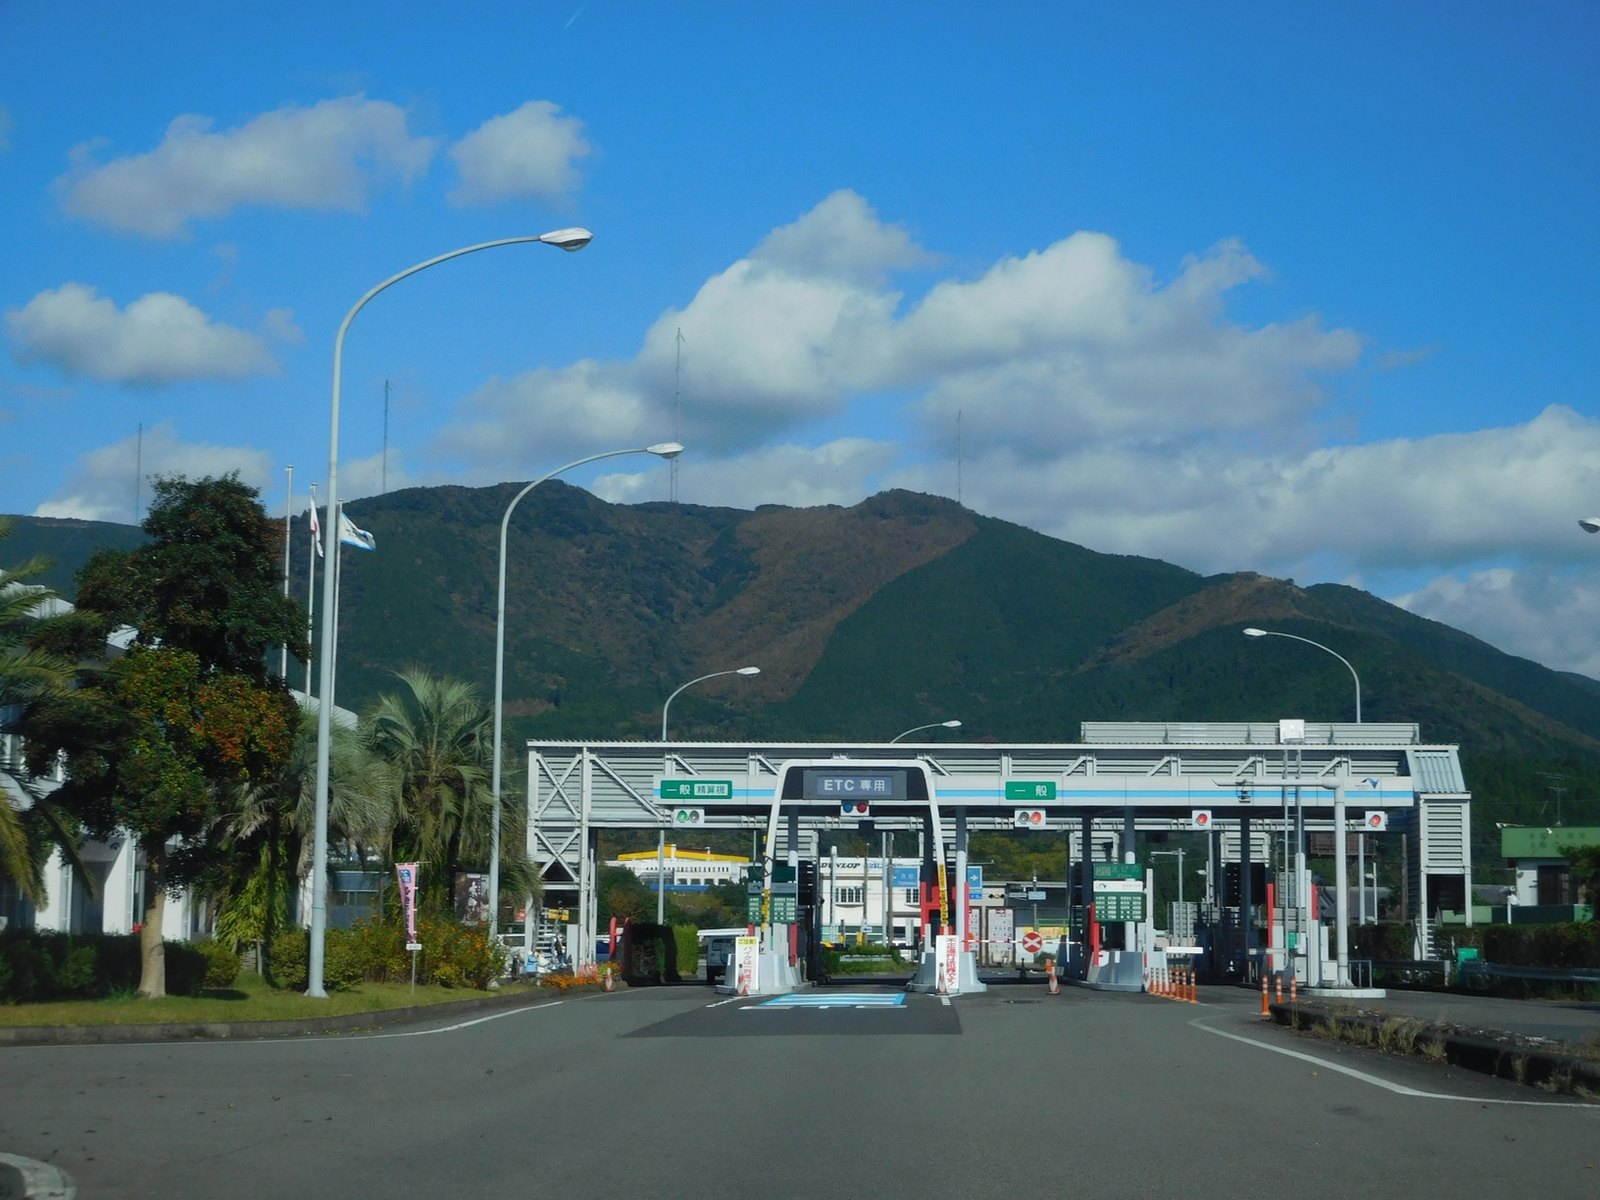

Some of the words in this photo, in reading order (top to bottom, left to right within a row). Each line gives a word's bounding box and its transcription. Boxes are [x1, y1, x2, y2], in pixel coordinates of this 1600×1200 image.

[666, 784, 691, 795] 一般
[695, 784, 727, 795] 精算機
[823, 779, 854, 791] ETC
[860, 779, 886, 792] 専用
[1014, 784, 1048, 797] 一般
[1112, 865, 1140, 873] えびの
